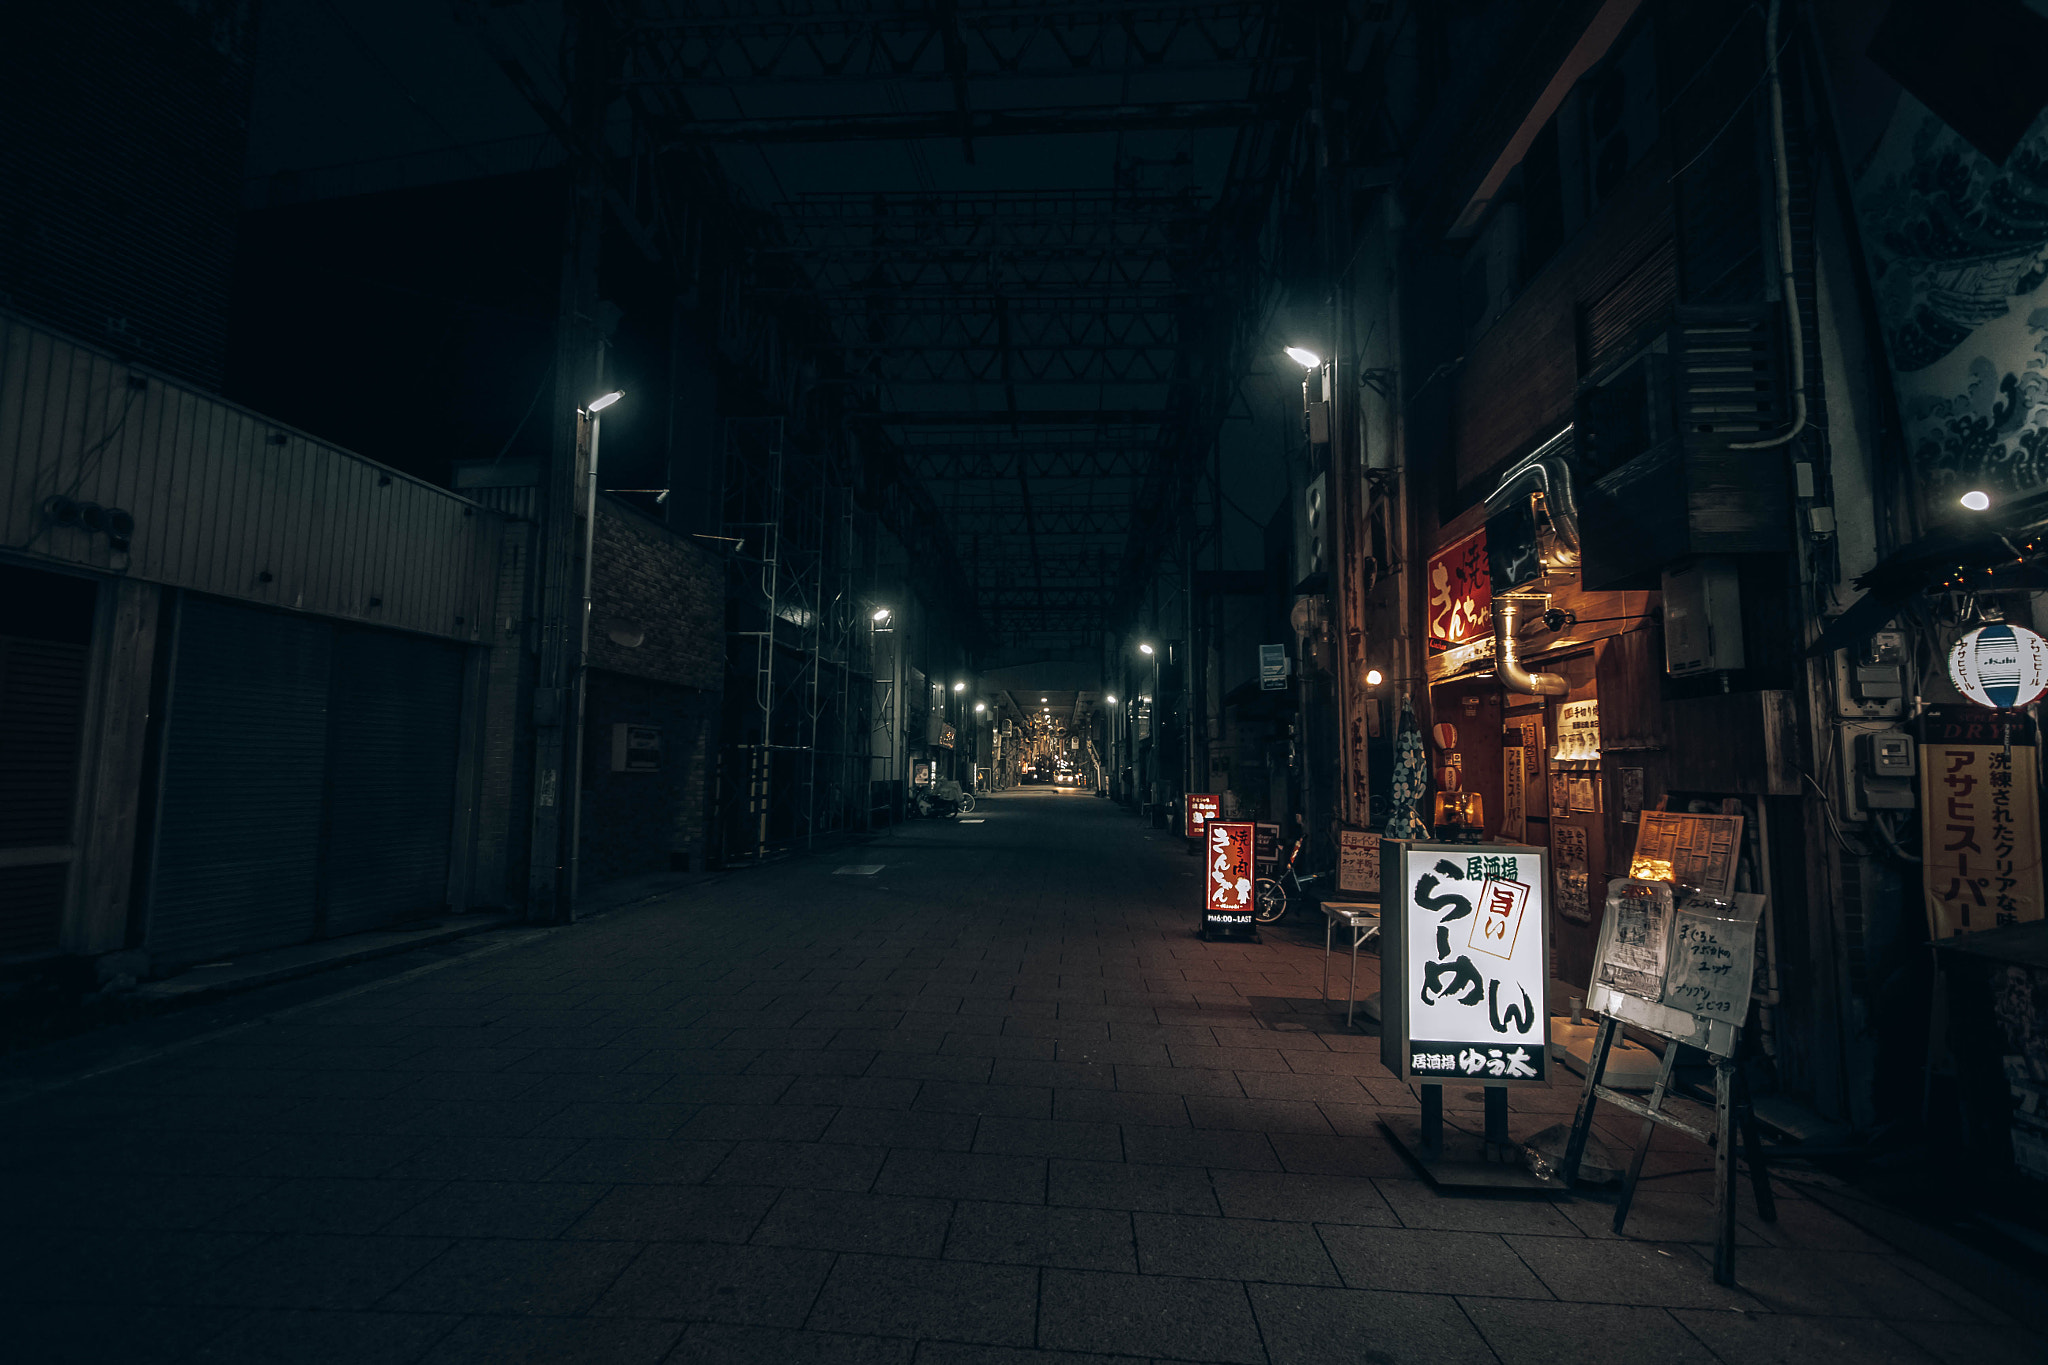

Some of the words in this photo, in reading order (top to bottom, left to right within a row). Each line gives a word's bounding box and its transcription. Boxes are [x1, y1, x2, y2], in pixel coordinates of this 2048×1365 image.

[2026, 637, 2043, 687] アサヒビール
[1230, 830, 1250, 876] 焼き肉
[1944, 751, 1989, 936] アサヒスーパー
[1466, 856, 1518, 881] 居酒場
[1414, 859, 1534, 1033] らーめん
[1679, 924, 1717, 944] まぐろと
[1698, 961, 1732, 976] ユッケ
[1696, 1002, 1731, 1012] エビマヨ
[1412, 1053, 1456, 1070] 居酒場
[1459, 1046, 1538, 1078] ゆう太
